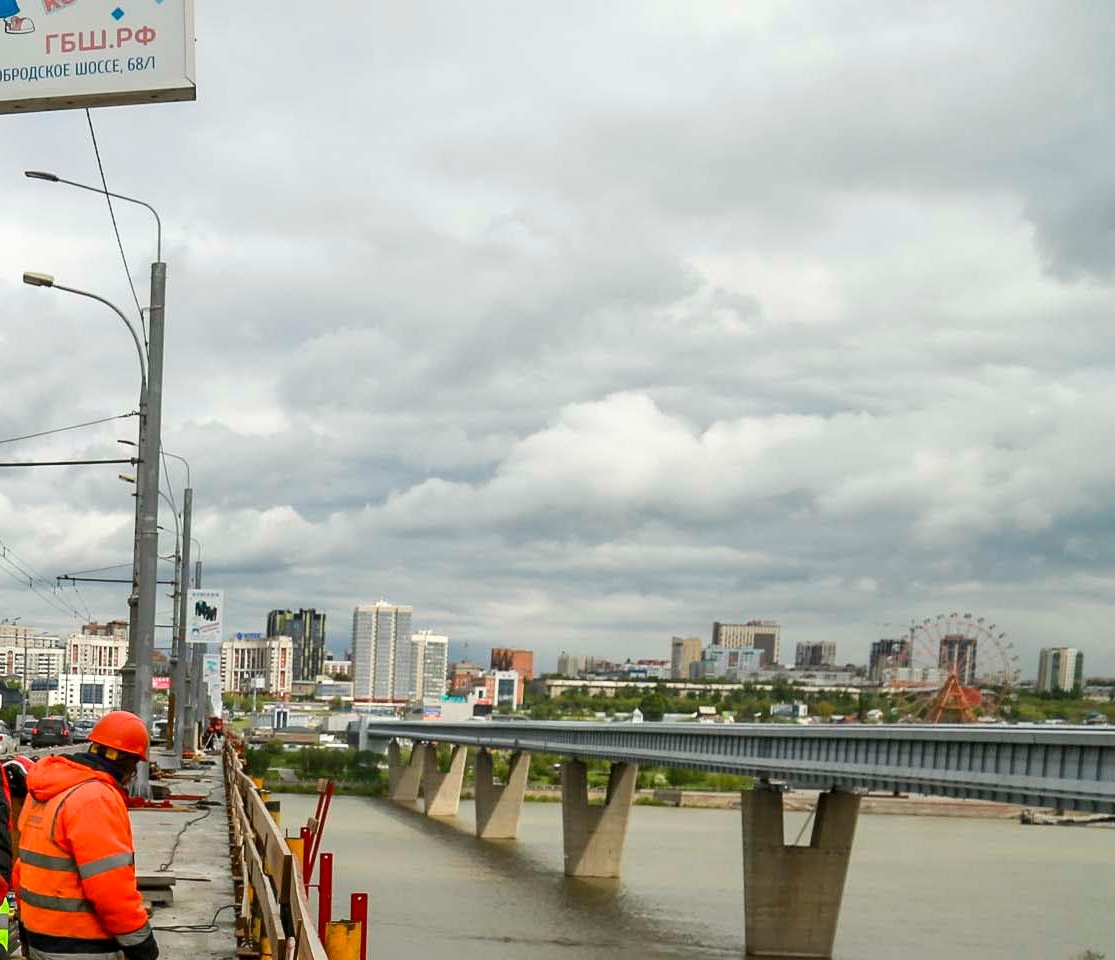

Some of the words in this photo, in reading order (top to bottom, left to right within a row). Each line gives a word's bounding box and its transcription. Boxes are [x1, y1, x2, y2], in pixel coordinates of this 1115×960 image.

[45, 25, 157, 55] ГБШ.РФ
[75, 59, 123, 76] ШОССЕ,
[127, 55, 156, 72] 68/1
